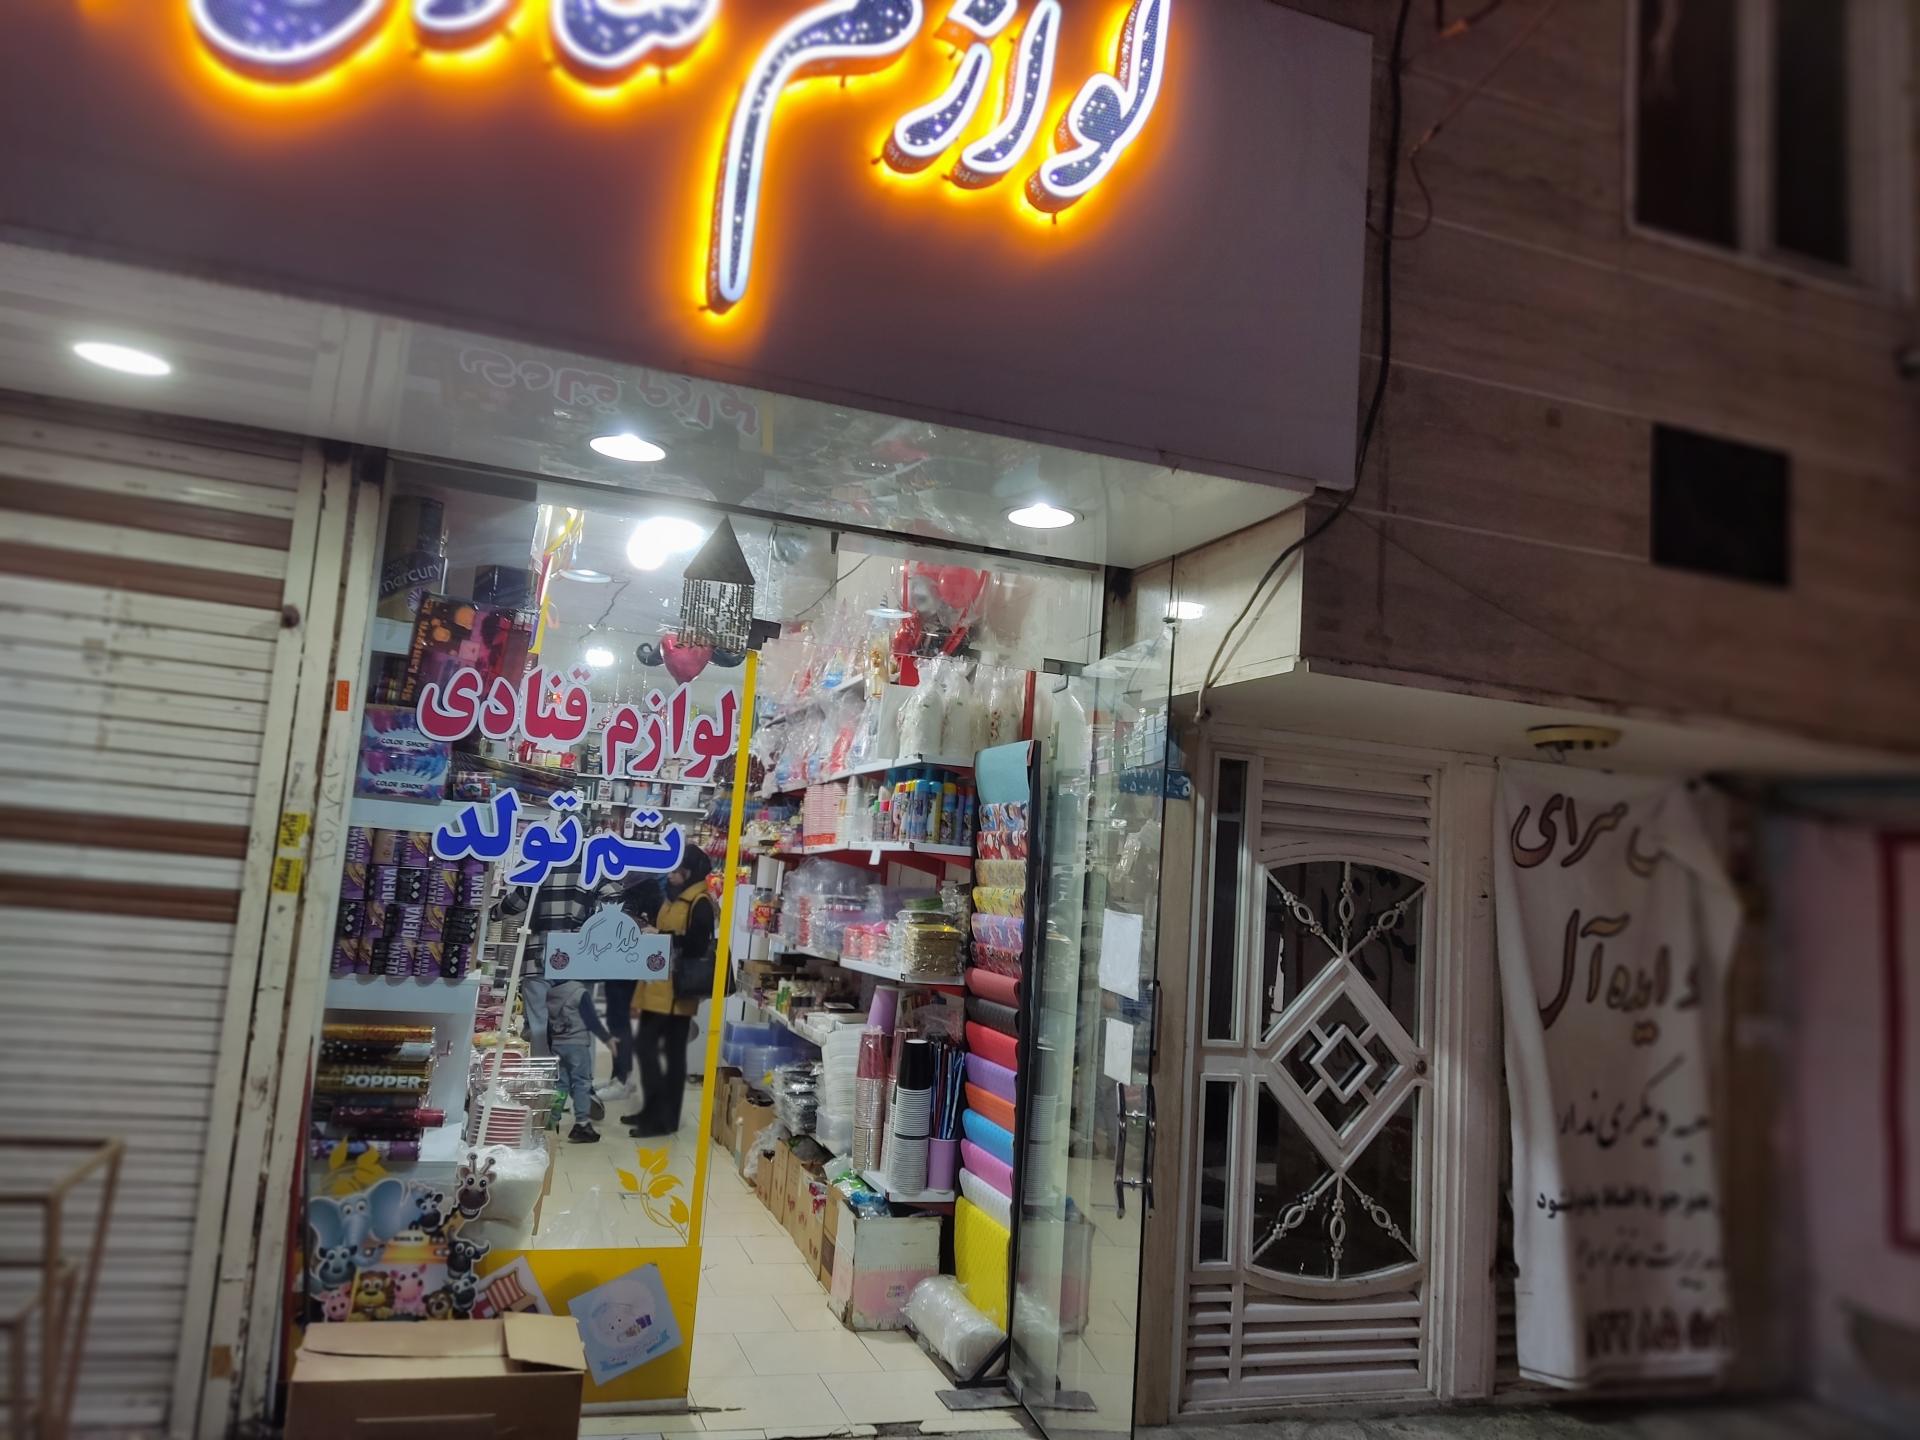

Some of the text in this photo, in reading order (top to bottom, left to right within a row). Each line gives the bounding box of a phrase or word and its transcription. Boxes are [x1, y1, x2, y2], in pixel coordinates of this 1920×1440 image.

[416, 666, 737, 781] لوازم قنادی
[381, 738, 429, 748] COLOR SMOKE
[400, 782, 424, 790] SMOKE
[432, 787, 585, 886] تولد
[579, 806, 686, 887] تم
[402, 906, 422, 938] DENA
[343, 1074, 421, 1089] POPPER
